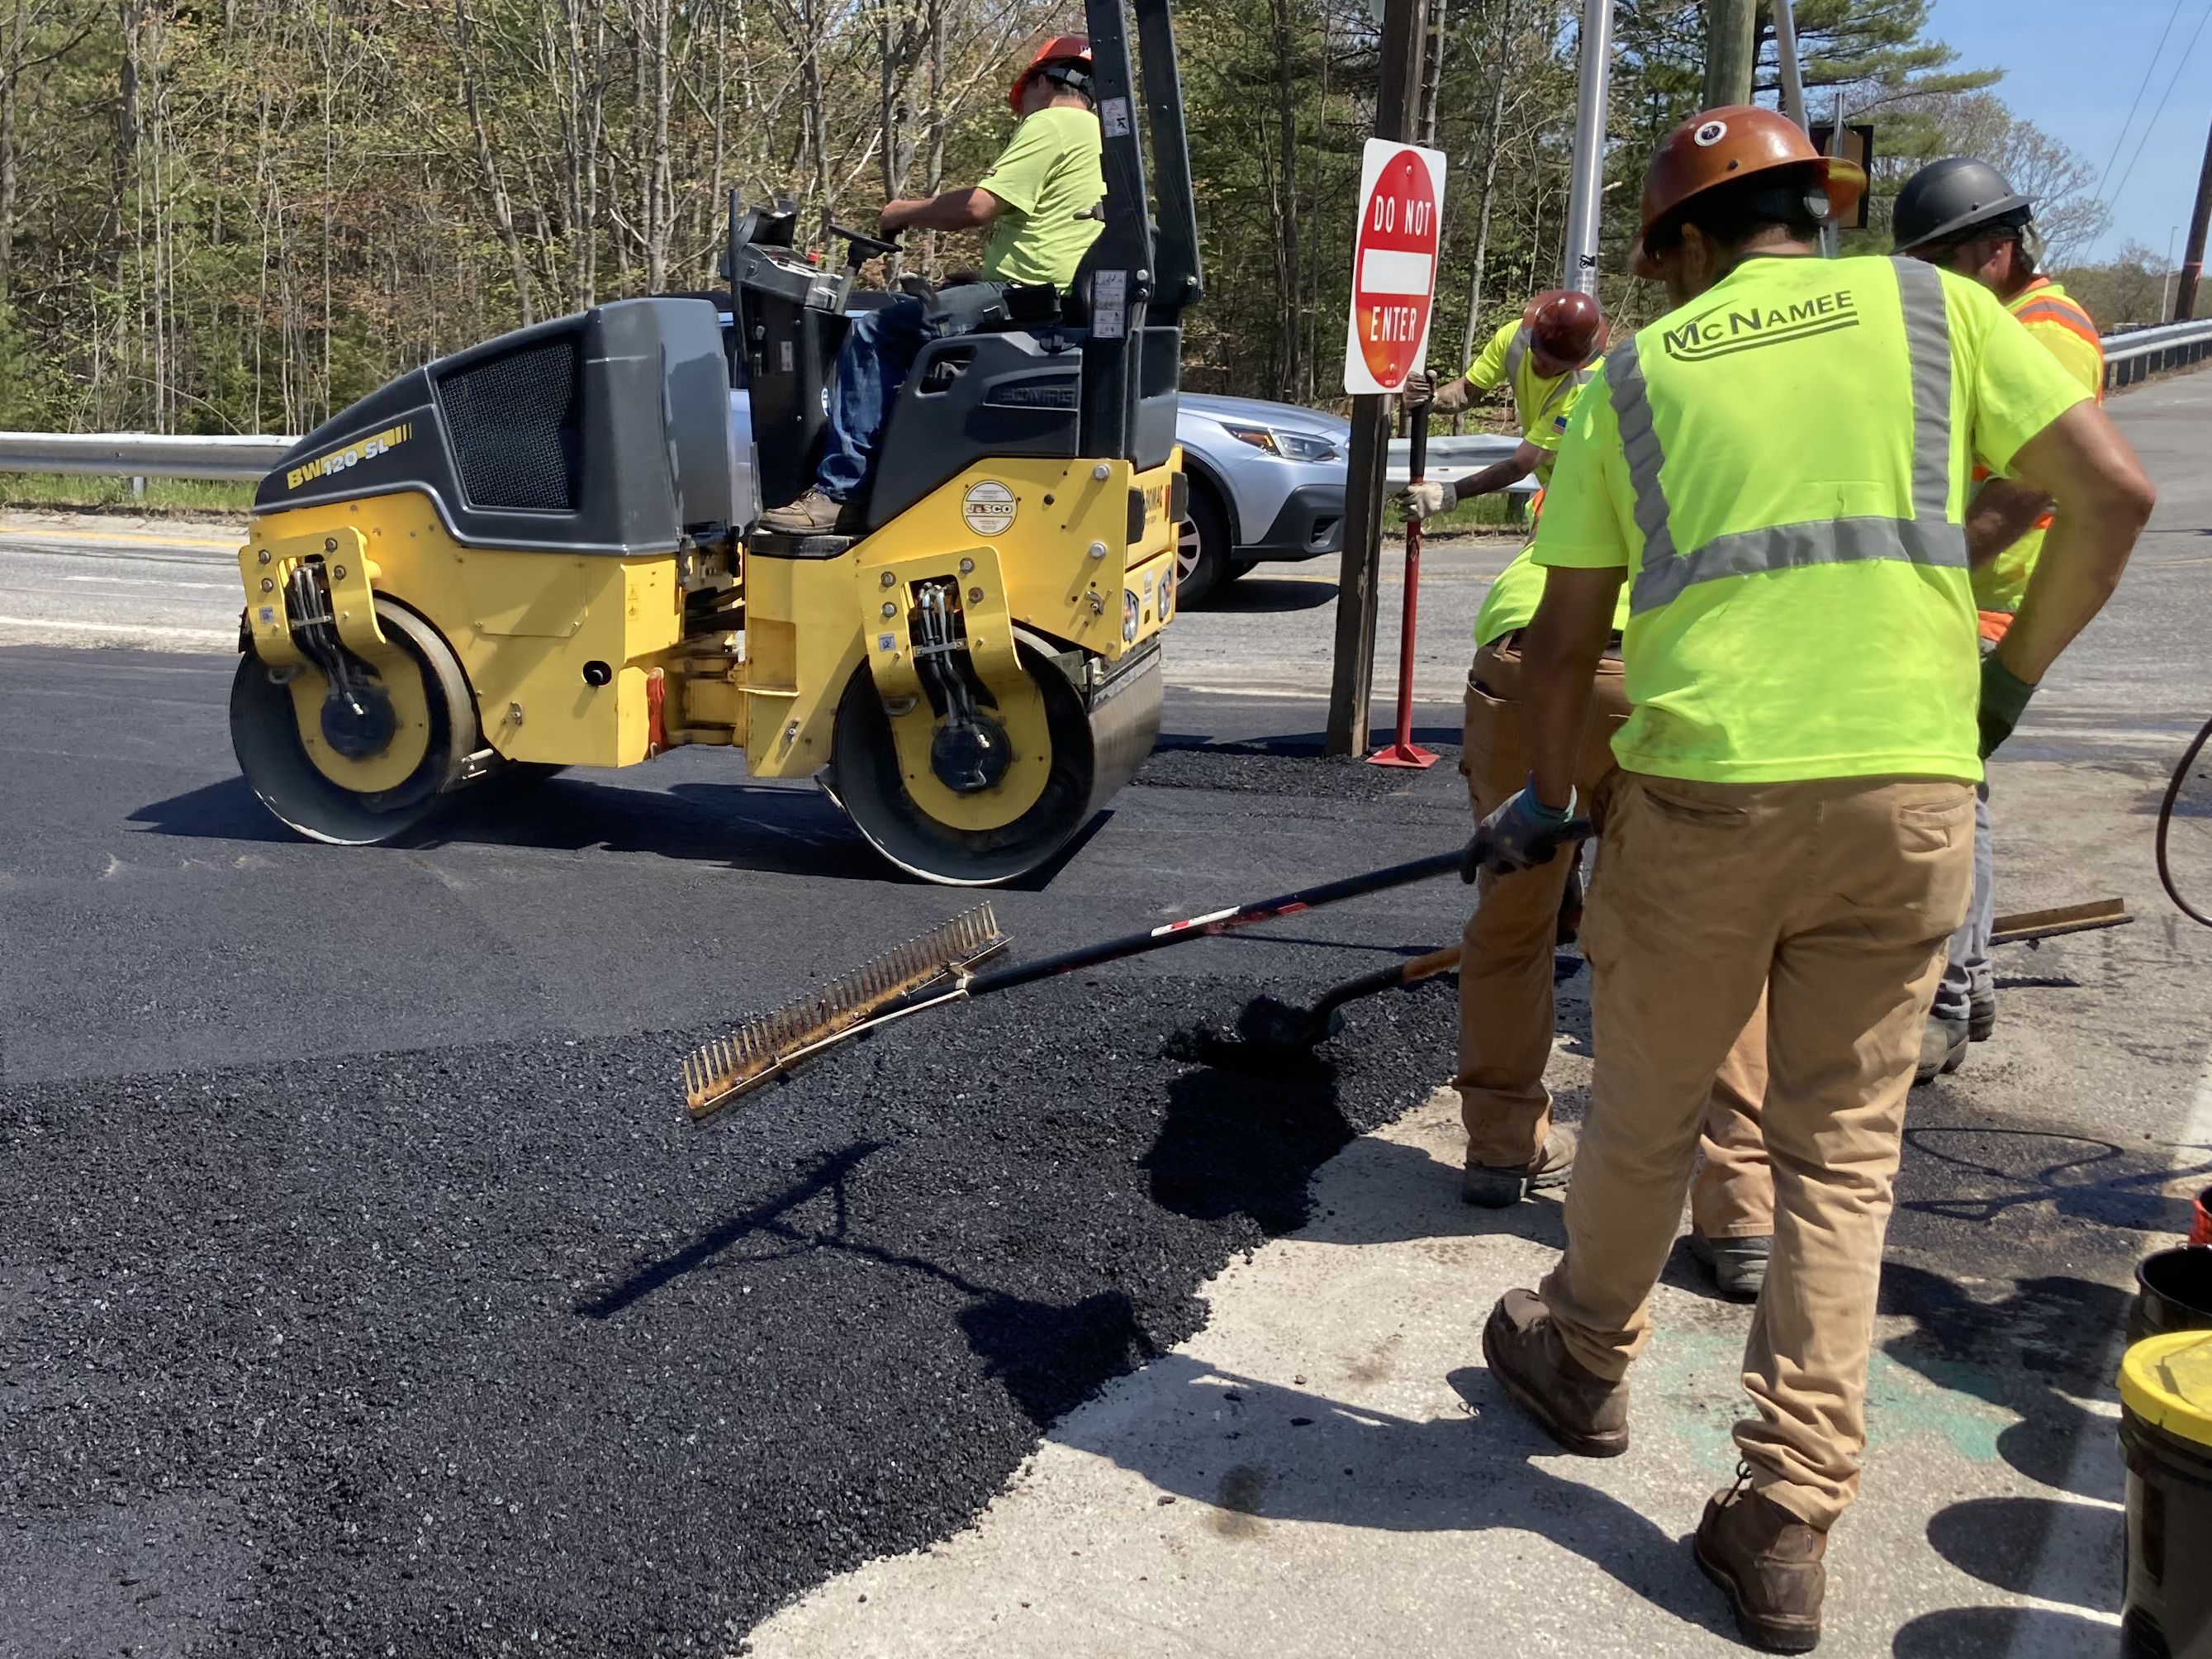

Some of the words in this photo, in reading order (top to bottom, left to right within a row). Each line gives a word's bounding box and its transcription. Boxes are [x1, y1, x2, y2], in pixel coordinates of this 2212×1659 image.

[1373, 195, 1395, 233] DO
[1405, 199, 1431, 236] NOT
[1370, 306, 1417, 342] ENTER
[364, 438, 389, 459] SL
